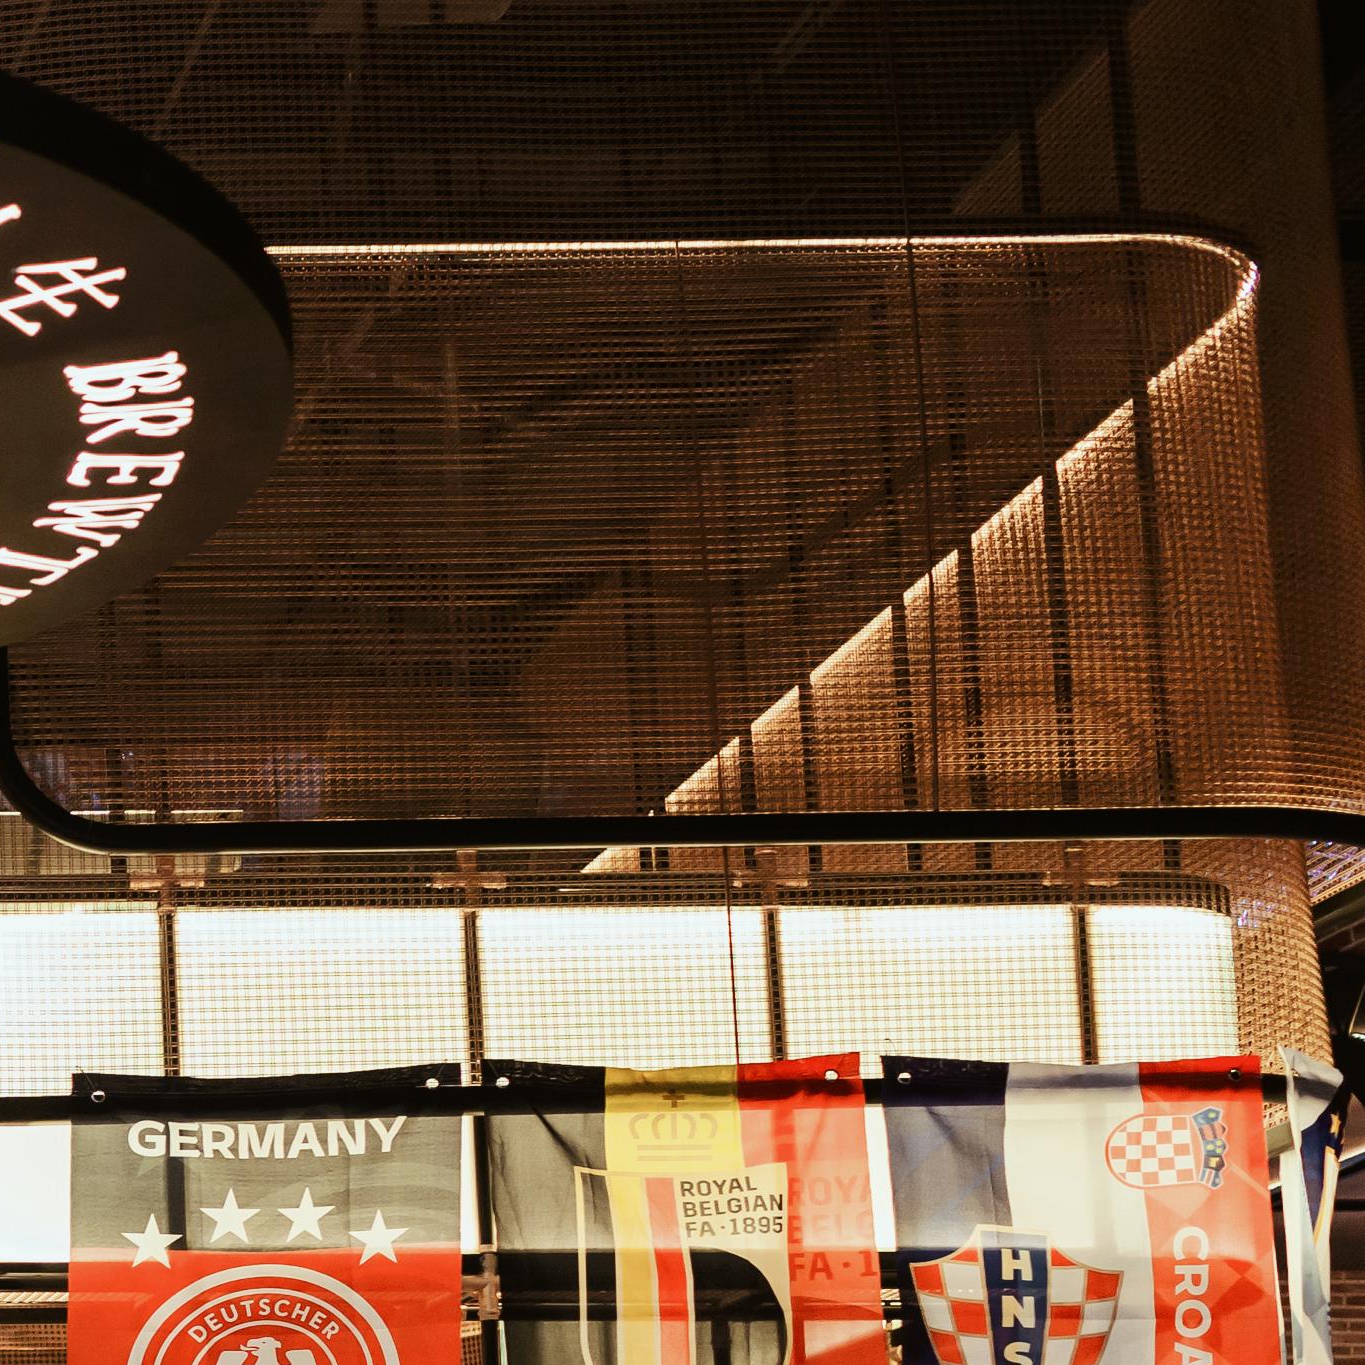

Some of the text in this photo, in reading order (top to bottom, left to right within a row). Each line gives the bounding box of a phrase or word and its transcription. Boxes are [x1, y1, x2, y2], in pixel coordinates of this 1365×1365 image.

[126, 1116, 408, 1160] GERMANY
[680, 1176, 758, 1198] ROYAL
[682, 1193, 783, 1218] BELGIAN
[187, 1297, 342, 1344] DEUTSCHER
